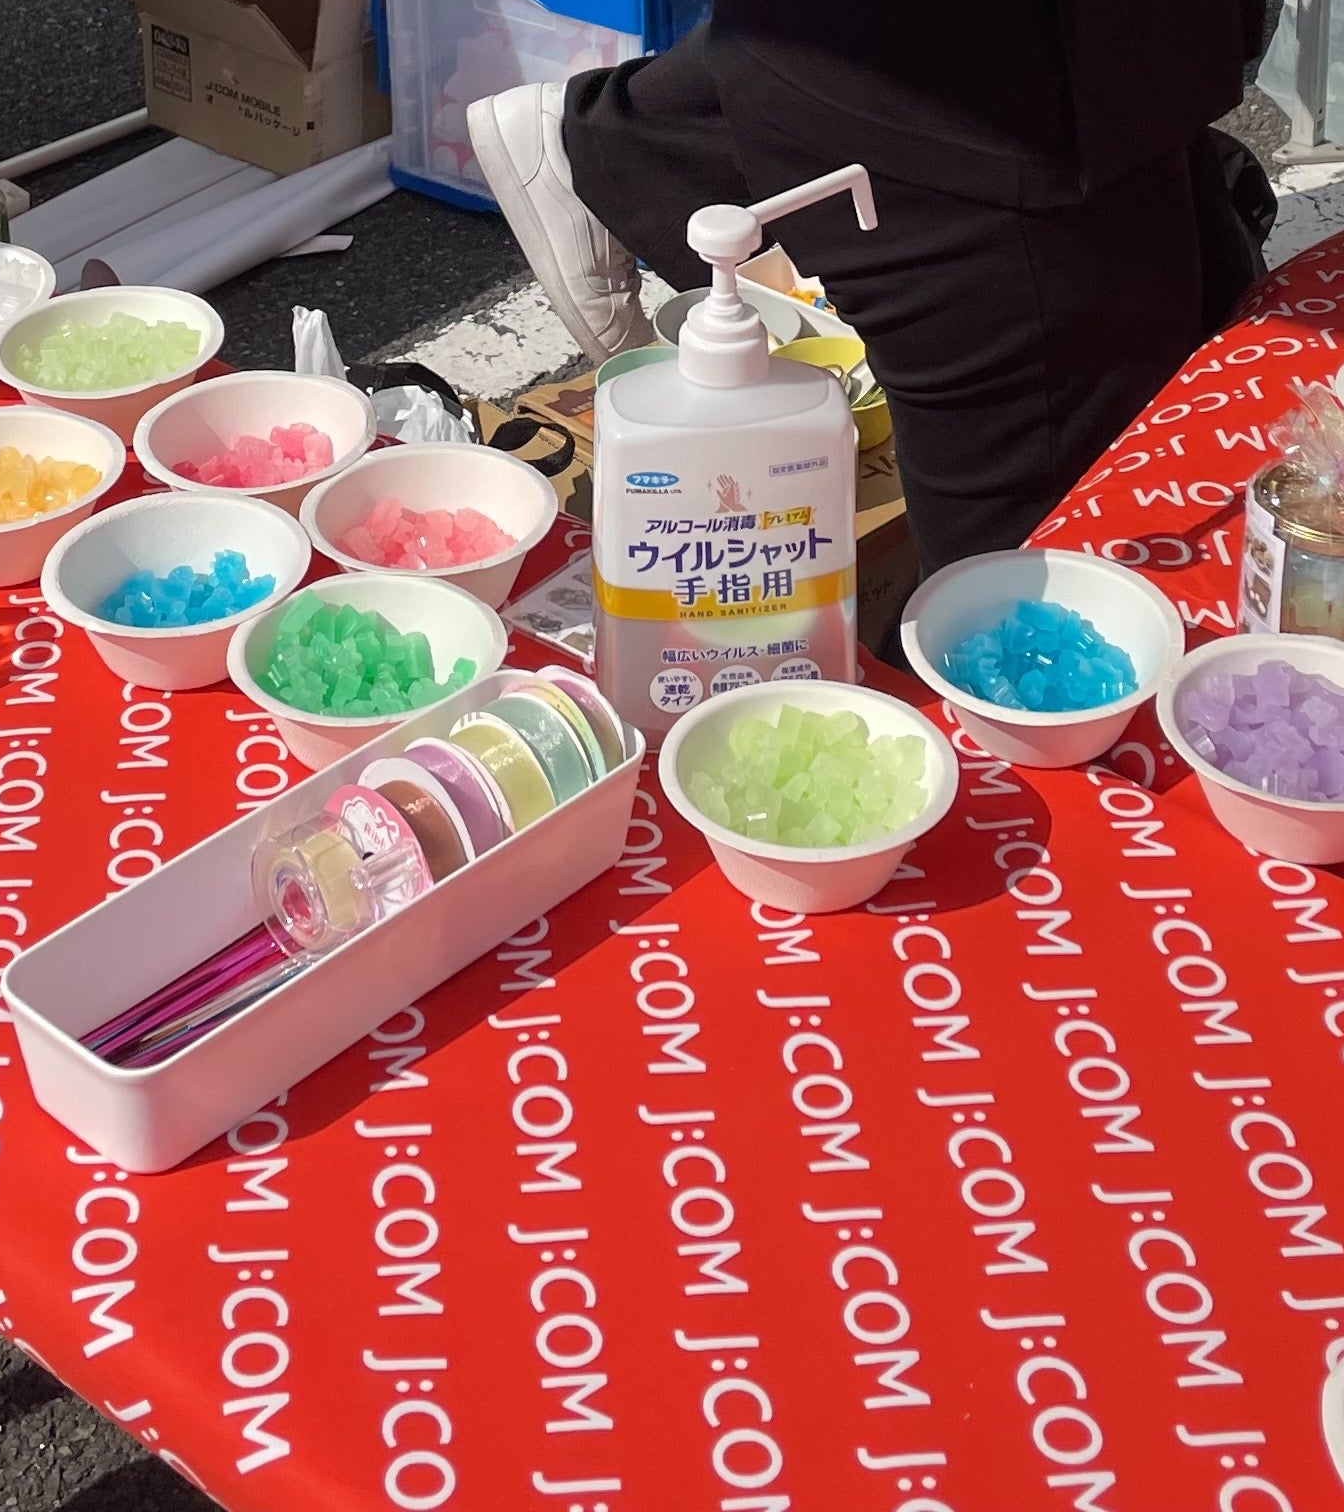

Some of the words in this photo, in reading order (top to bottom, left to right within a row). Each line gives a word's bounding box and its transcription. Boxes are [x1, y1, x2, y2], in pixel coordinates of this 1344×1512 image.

[240, 93, 281, 116] MOBILE
[1108, 376, 1265, 451] J:COM
[1179, 327, 1338, 385] J:COM
[628, 528, 833, 572] ウイルシャット
[645, 515, 756, 533] アルコール消毒
[673, 568, 793, 605] 手指用
[766, 511, 808, 525] プレミアム
[6, 594, 64, 705] J:COM
[662, 639, 808, 663] 幅広いウイルス・細菌に
[720, 604, 788, 616] SANITIZER
[225, 709, 288, 811] J:CO
[660, 695, 697, 706] タイプ
[664, 684, 691, 695] 速乾
[100, 790, 166, 899] J:CO
[966, 816, 1083, 955] J:COM
[609, 919, 707, 1074] J:COM
[867, 900, 981, 1062] J:COM
[1120, 880, 1253, 1046] J:COM
[488, 1014, 582, 1193] J:COM
[756, 988, 871, 1173] J:COM
[1023, 981, 1154, 1155] J:COM
[356, 1120, 445, 1317] J:COM
[638, 1105, 749, 1296] J:COM
[916, 1088, 1049, 1276] J:COM
[1193, 1071, 1344, 1259] J:COM
[66, 1146, 140, 1358] J:COM
[508, 1224, 614, 1433] J:COM
[802, 1203, 932, 1409] J:COM
[1092, 1183, 1244, 1389] J:COM
[208, 1243, 290, 1474] J:COM
[362, 1350, 456, 1512] J:CO
